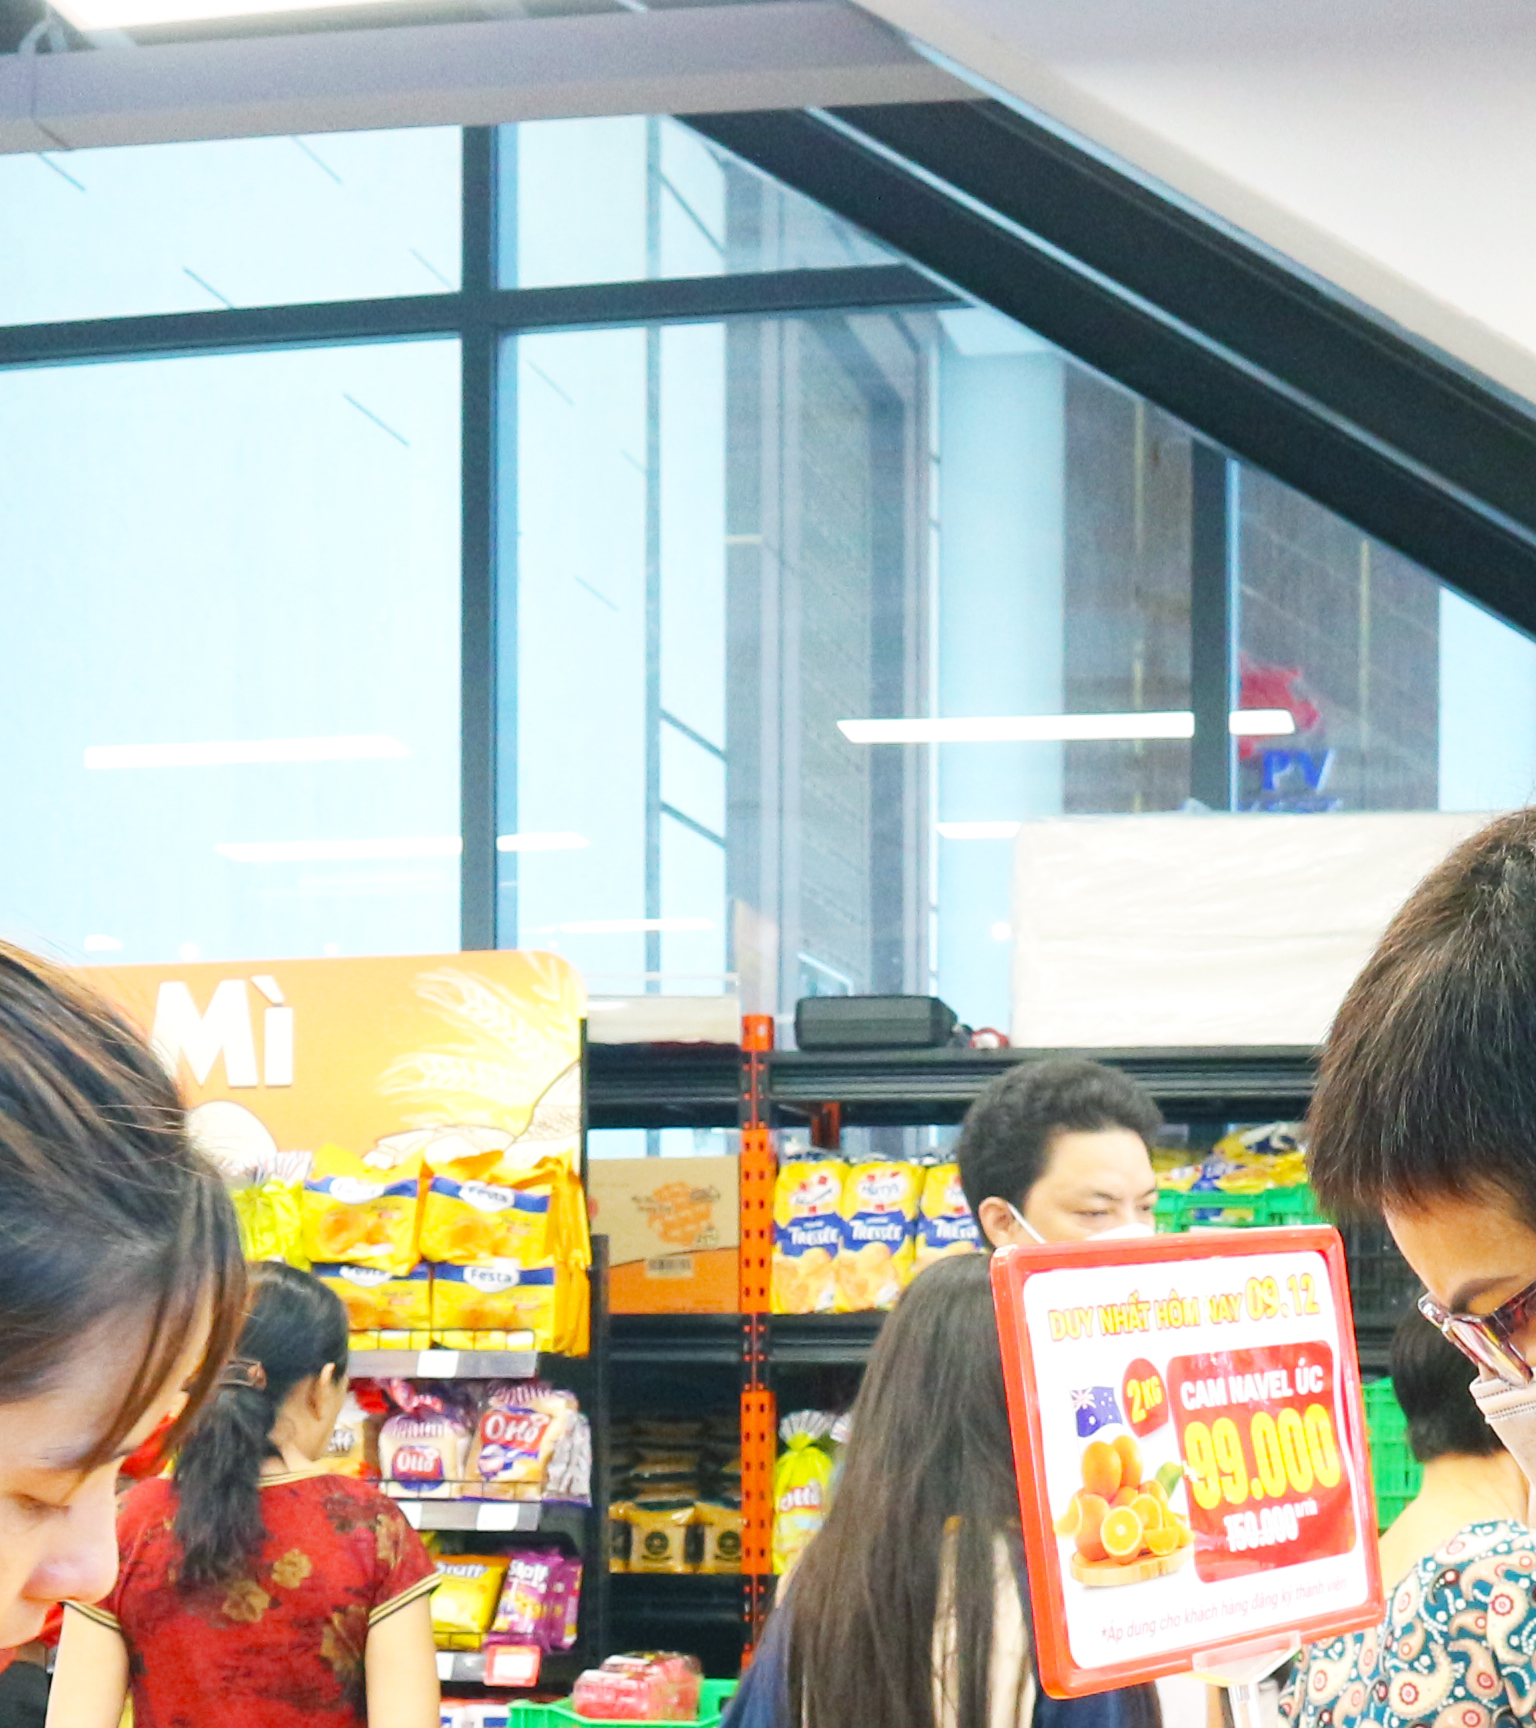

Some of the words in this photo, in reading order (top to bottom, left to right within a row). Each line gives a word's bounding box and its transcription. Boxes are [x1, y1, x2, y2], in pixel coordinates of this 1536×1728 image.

[151, 974, 294, 1088] Mì
[470, 1269, 513, 1284] Festa
[1048, 1307, 1094, 1342] DUY
[1097, 1288, 1151, 1337] NHẤT
[1154, 1288, 1201, 1331] HÔM
[1205, 1292, 1243, 1325] NAY
[1244, 1272, 1321, 1322] 09.12
[1181, 1377, 1225, 1411] CAM
[1228, 1370, 1293, 1406] NAVEL
[1295, 1357, 1324, 1395] ÚC
[1183, 1402, 1342, 1511] 99.000
[1223, 1503, 1299, 1552] 150.000
[1160, 1611, 1181, 1631] cho
[1184, 1602, 1218, 1626] khách
[1221, 1598, 1248, 1619] hàng
